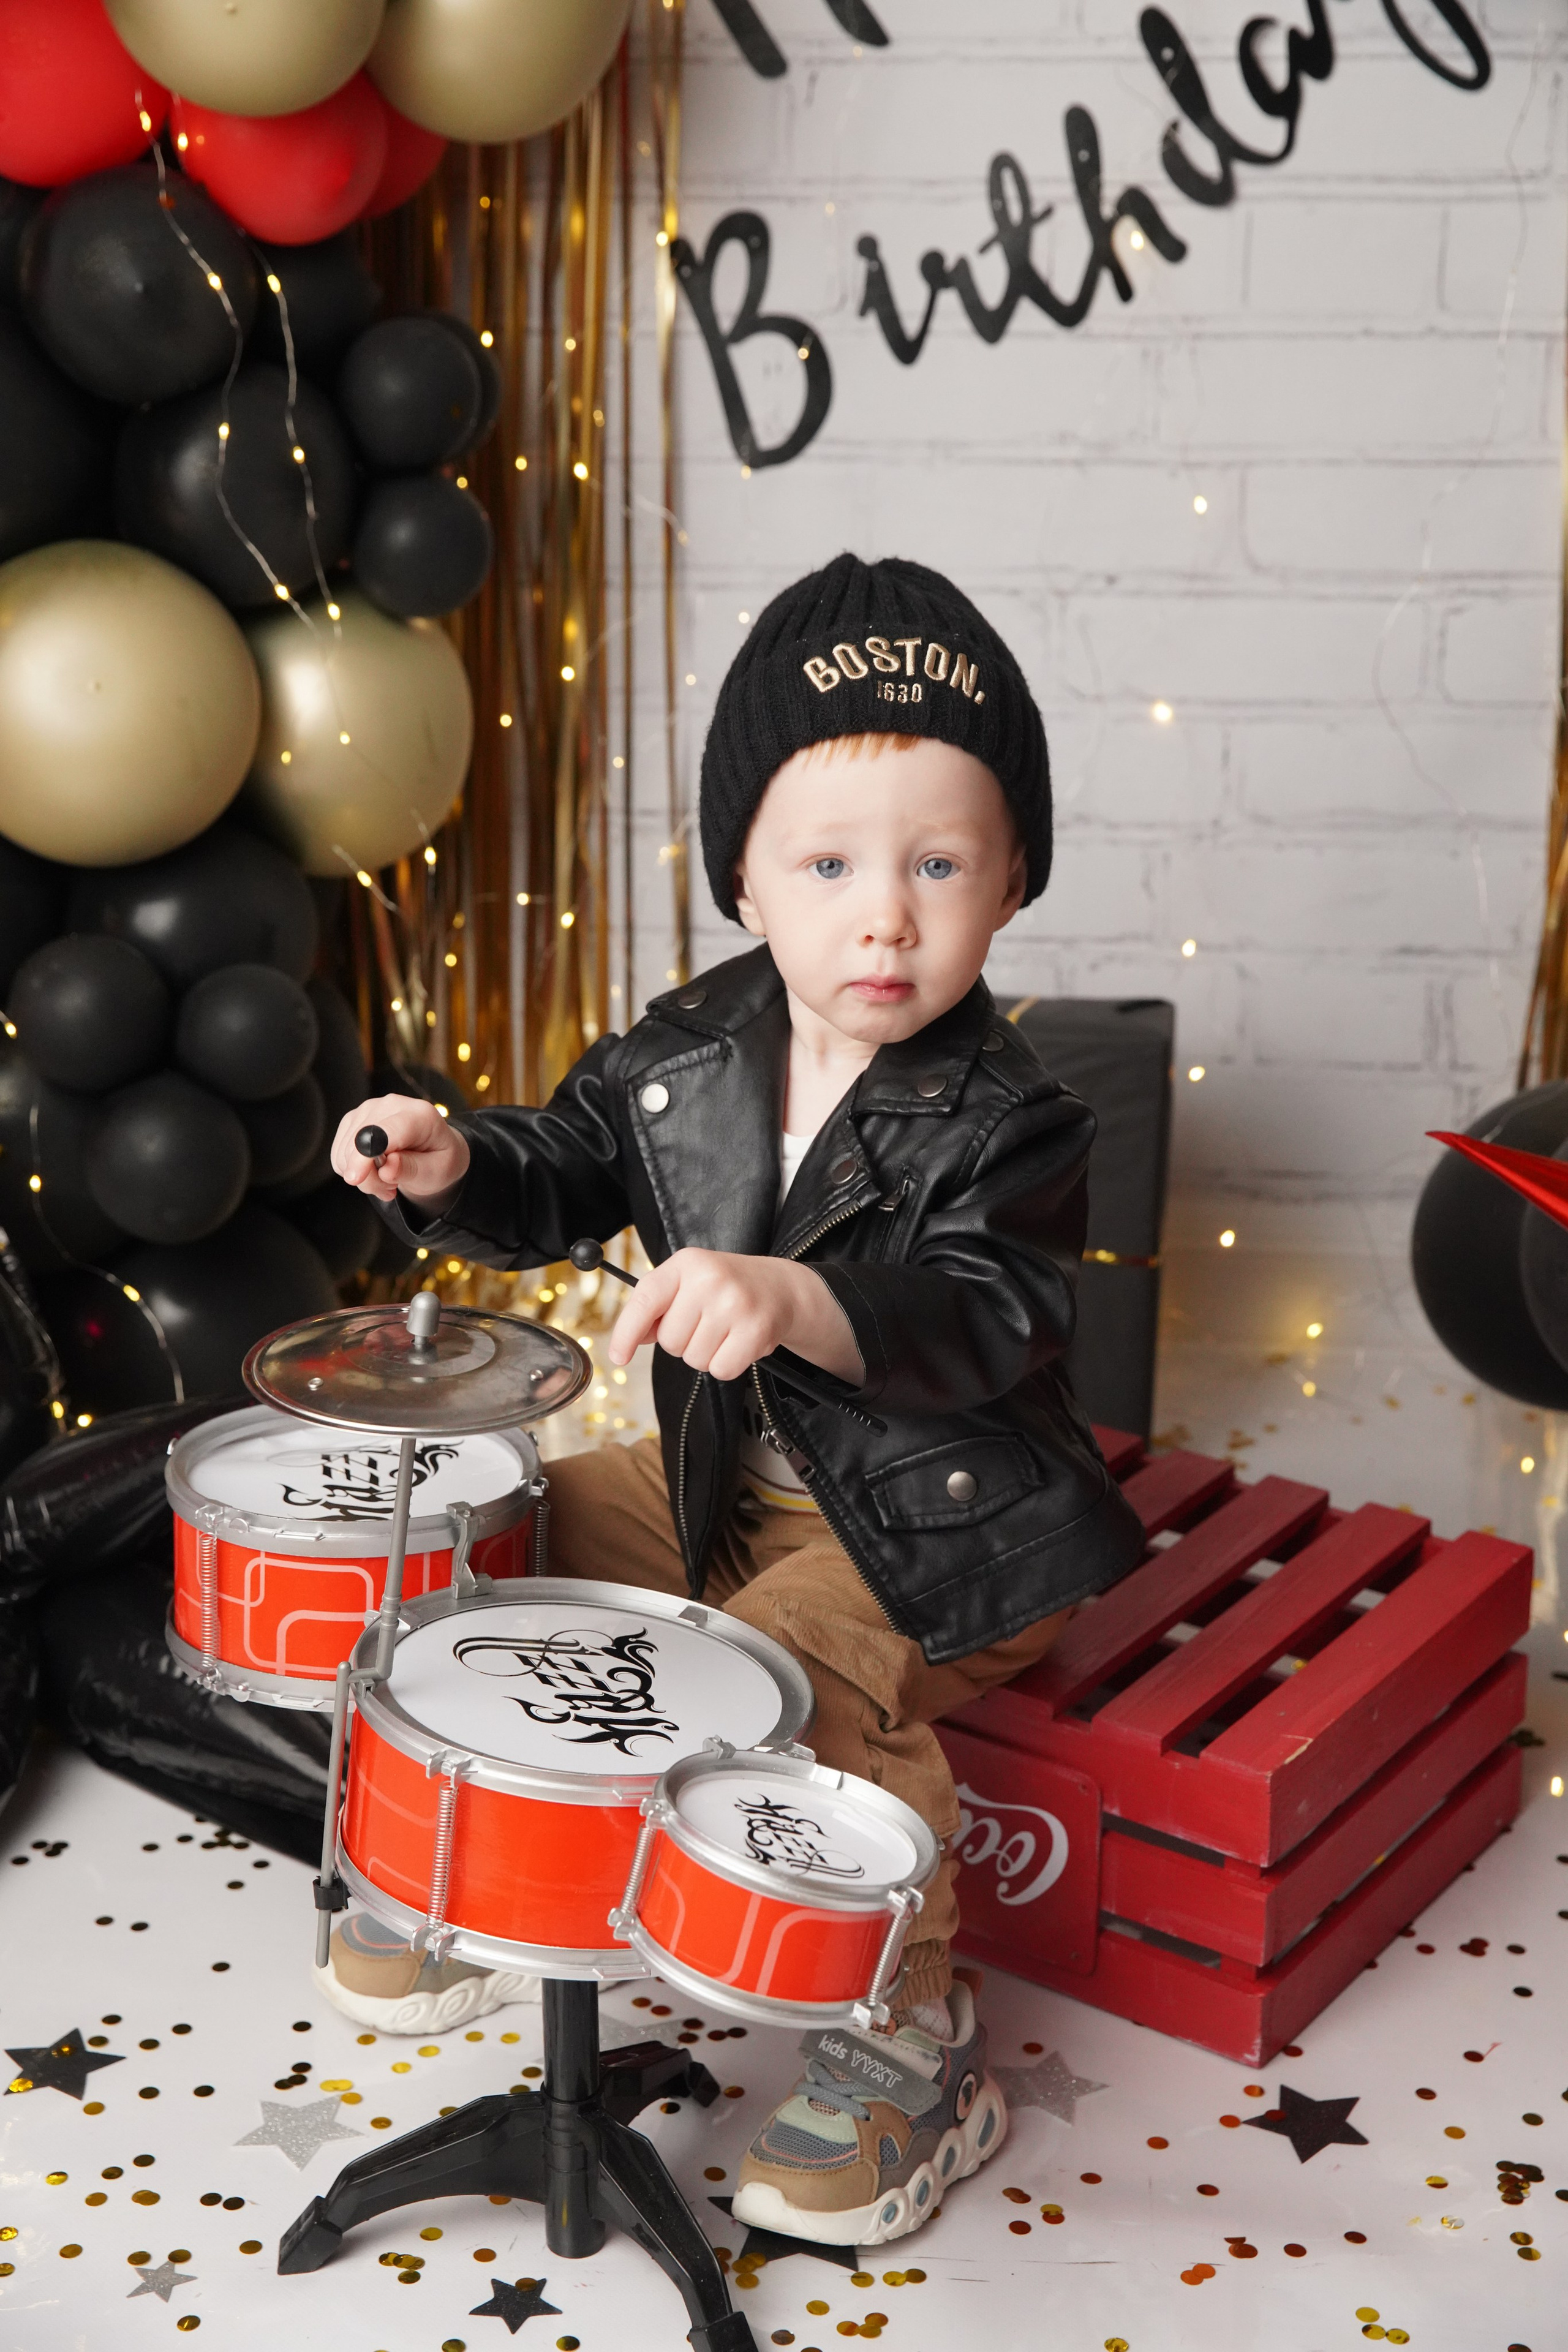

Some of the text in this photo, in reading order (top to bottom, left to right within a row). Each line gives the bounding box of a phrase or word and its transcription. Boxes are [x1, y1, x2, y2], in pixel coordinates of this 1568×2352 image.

[877, 681, 922, 703] 1630
[818, 2035, 903, 2088] kids YYXT
